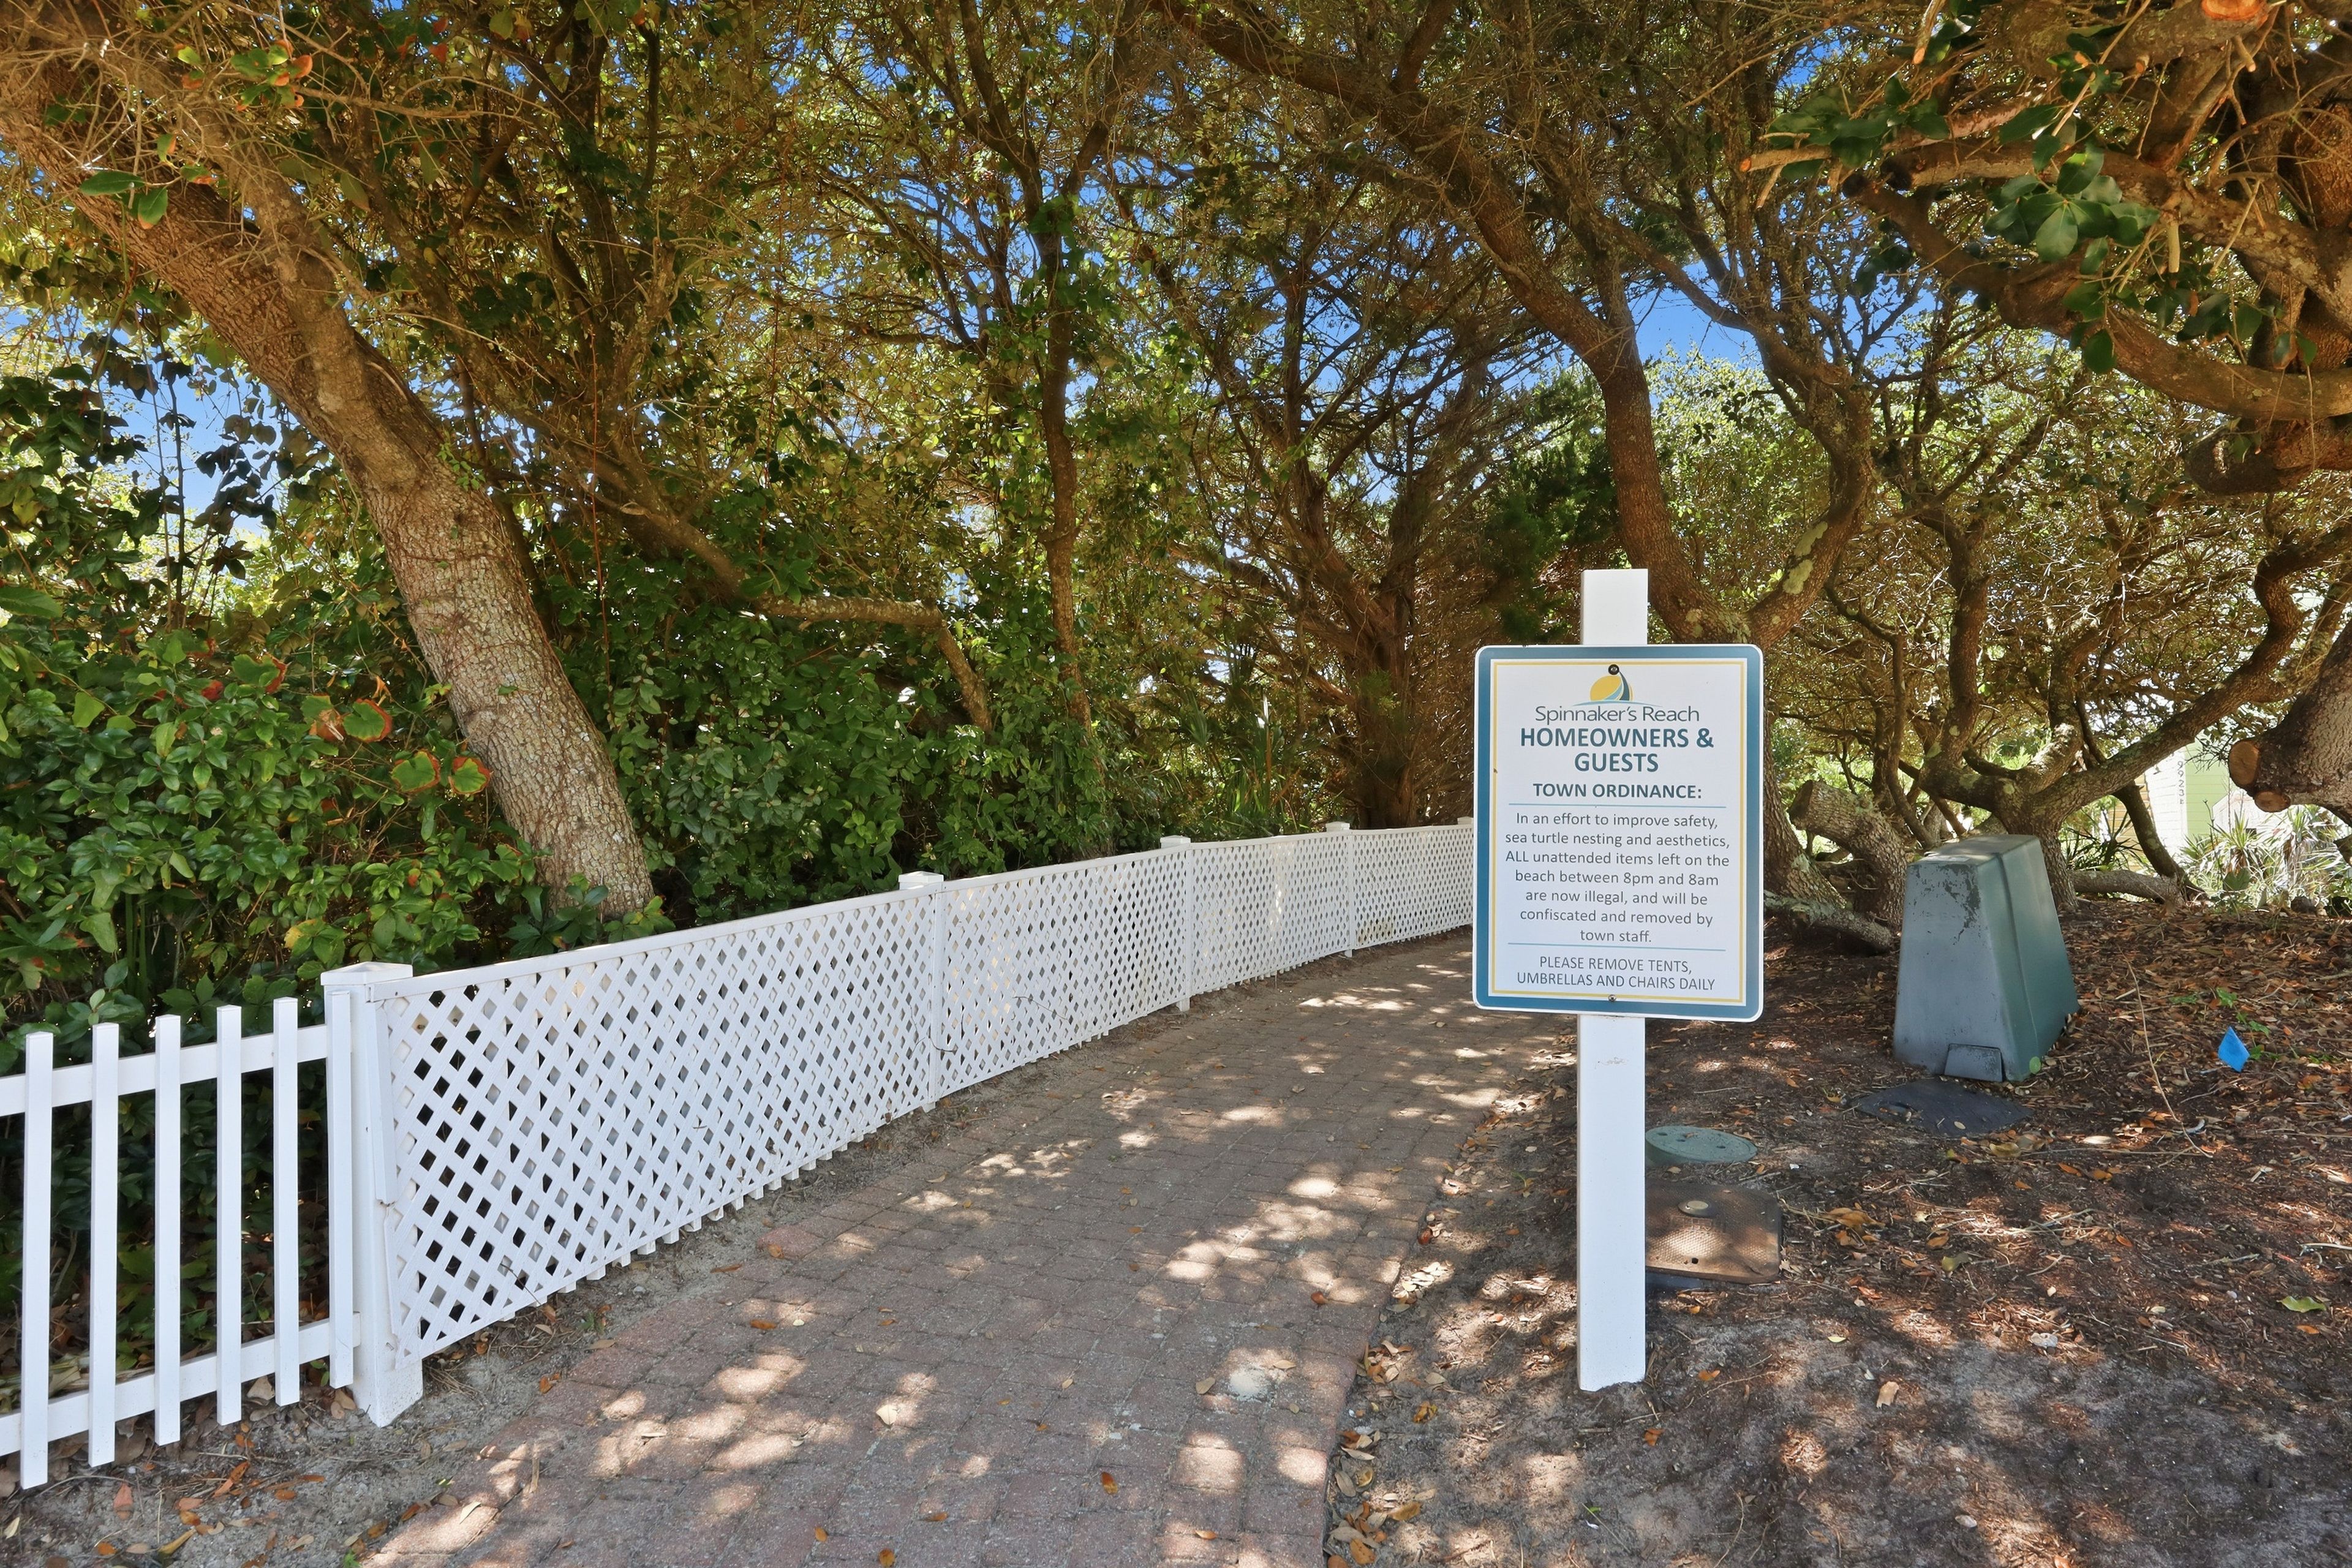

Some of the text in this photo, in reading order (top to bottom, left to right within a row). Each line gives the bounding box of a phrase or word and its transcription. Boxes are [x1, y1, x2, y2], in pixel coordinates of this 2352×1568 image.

[1535, 705, 1700, 726] Spinnaker's Reach
[1521, 727, 1714, 748] HOMEOWNERS &
[1574, 752, 1659, 772] GUESTS
[1532, 783, 1702, 799] TOWN ORDINANCE:
[1517, 812, 1717, 830] In an effort to improve safety,
[1505, 831, 1730, 849] sea turtle nesting and aesthetics,
[1505, 850, 1730, 867] ALL unattended items left on the
[1515, 869, 1719, 887] beach between 8pm and 8am
[1526, 890, 1708, 906] are now illegal, and will be
[1520, 908, 1713, 928] confiscated and removed by
[1580, 930, 1652, 943] town staff.
[1540, 956, 1692, 975] PLEASE REMOVE TENTS,
[1517, 972, 1715, 990] UMBRELLAS AND CHAIRS DAILY
